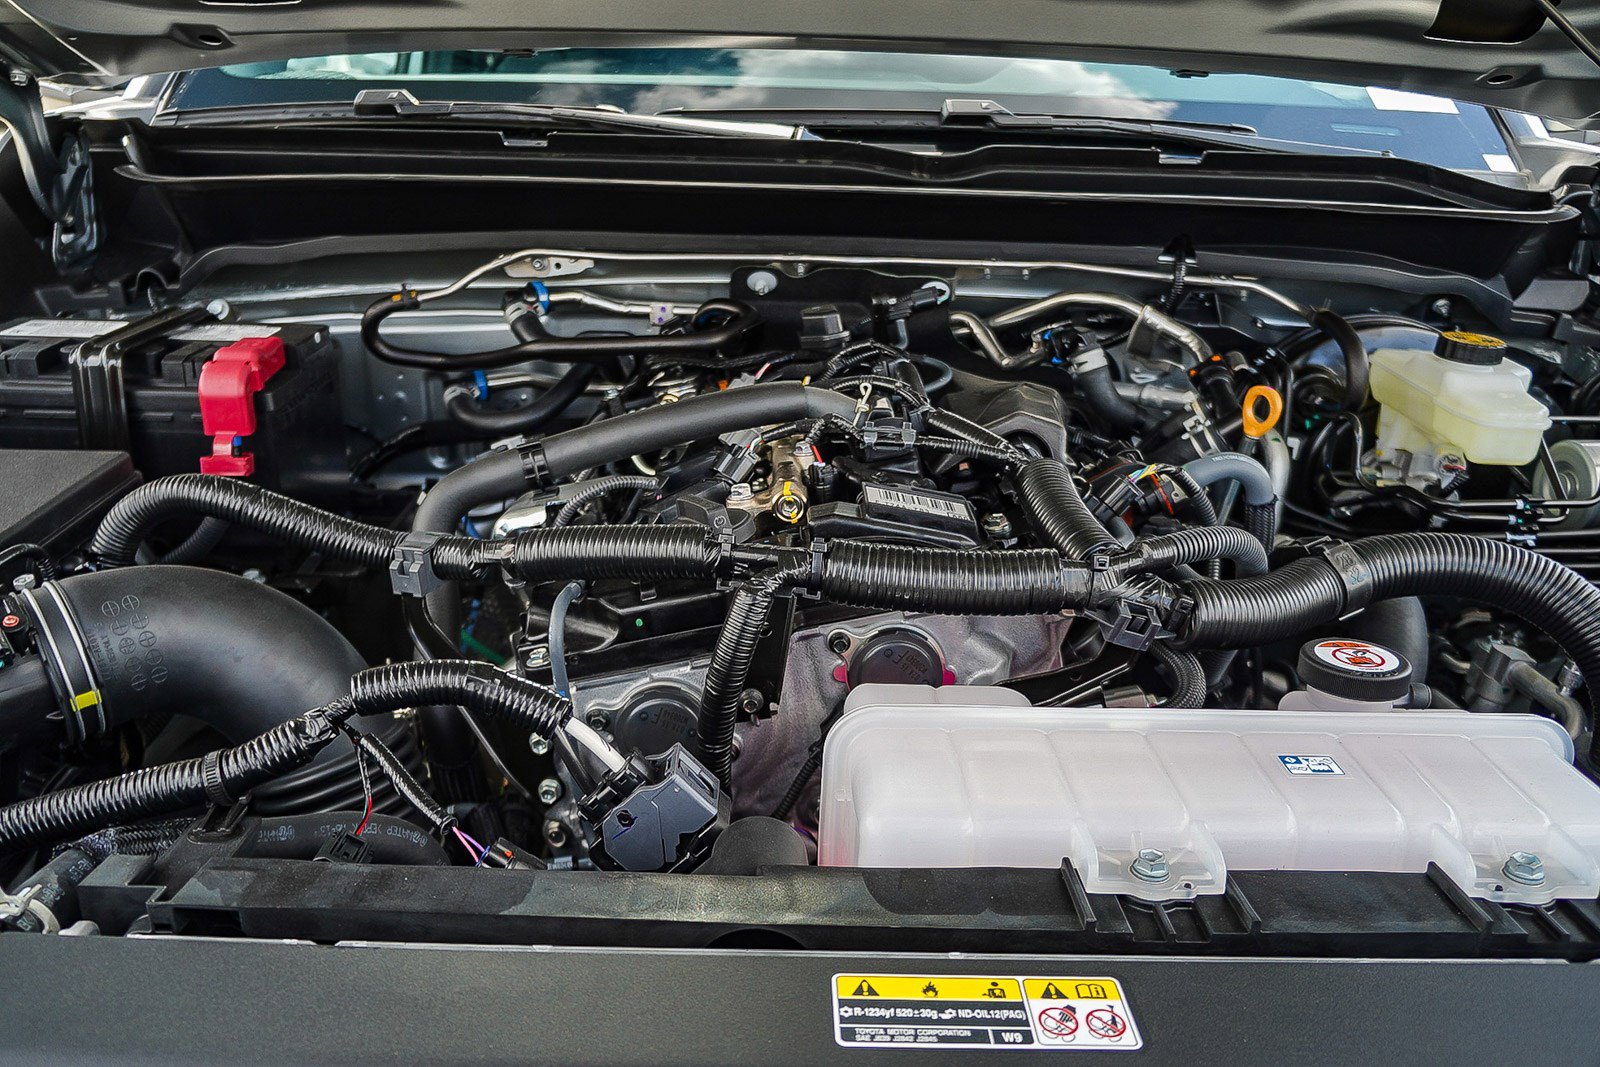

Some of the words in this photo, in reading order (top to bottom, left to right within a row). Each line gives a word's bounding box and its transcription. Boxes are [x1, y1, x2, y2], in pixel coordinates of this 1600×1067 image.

[896, 1008, 939, 1020] 520±30g
[958, 1009, 1027, 1021] ND-OIL12(PAG)
[916, 1029, 971, 1037] CORPORATION
[1001, 1032, 1023, 1043] W9
